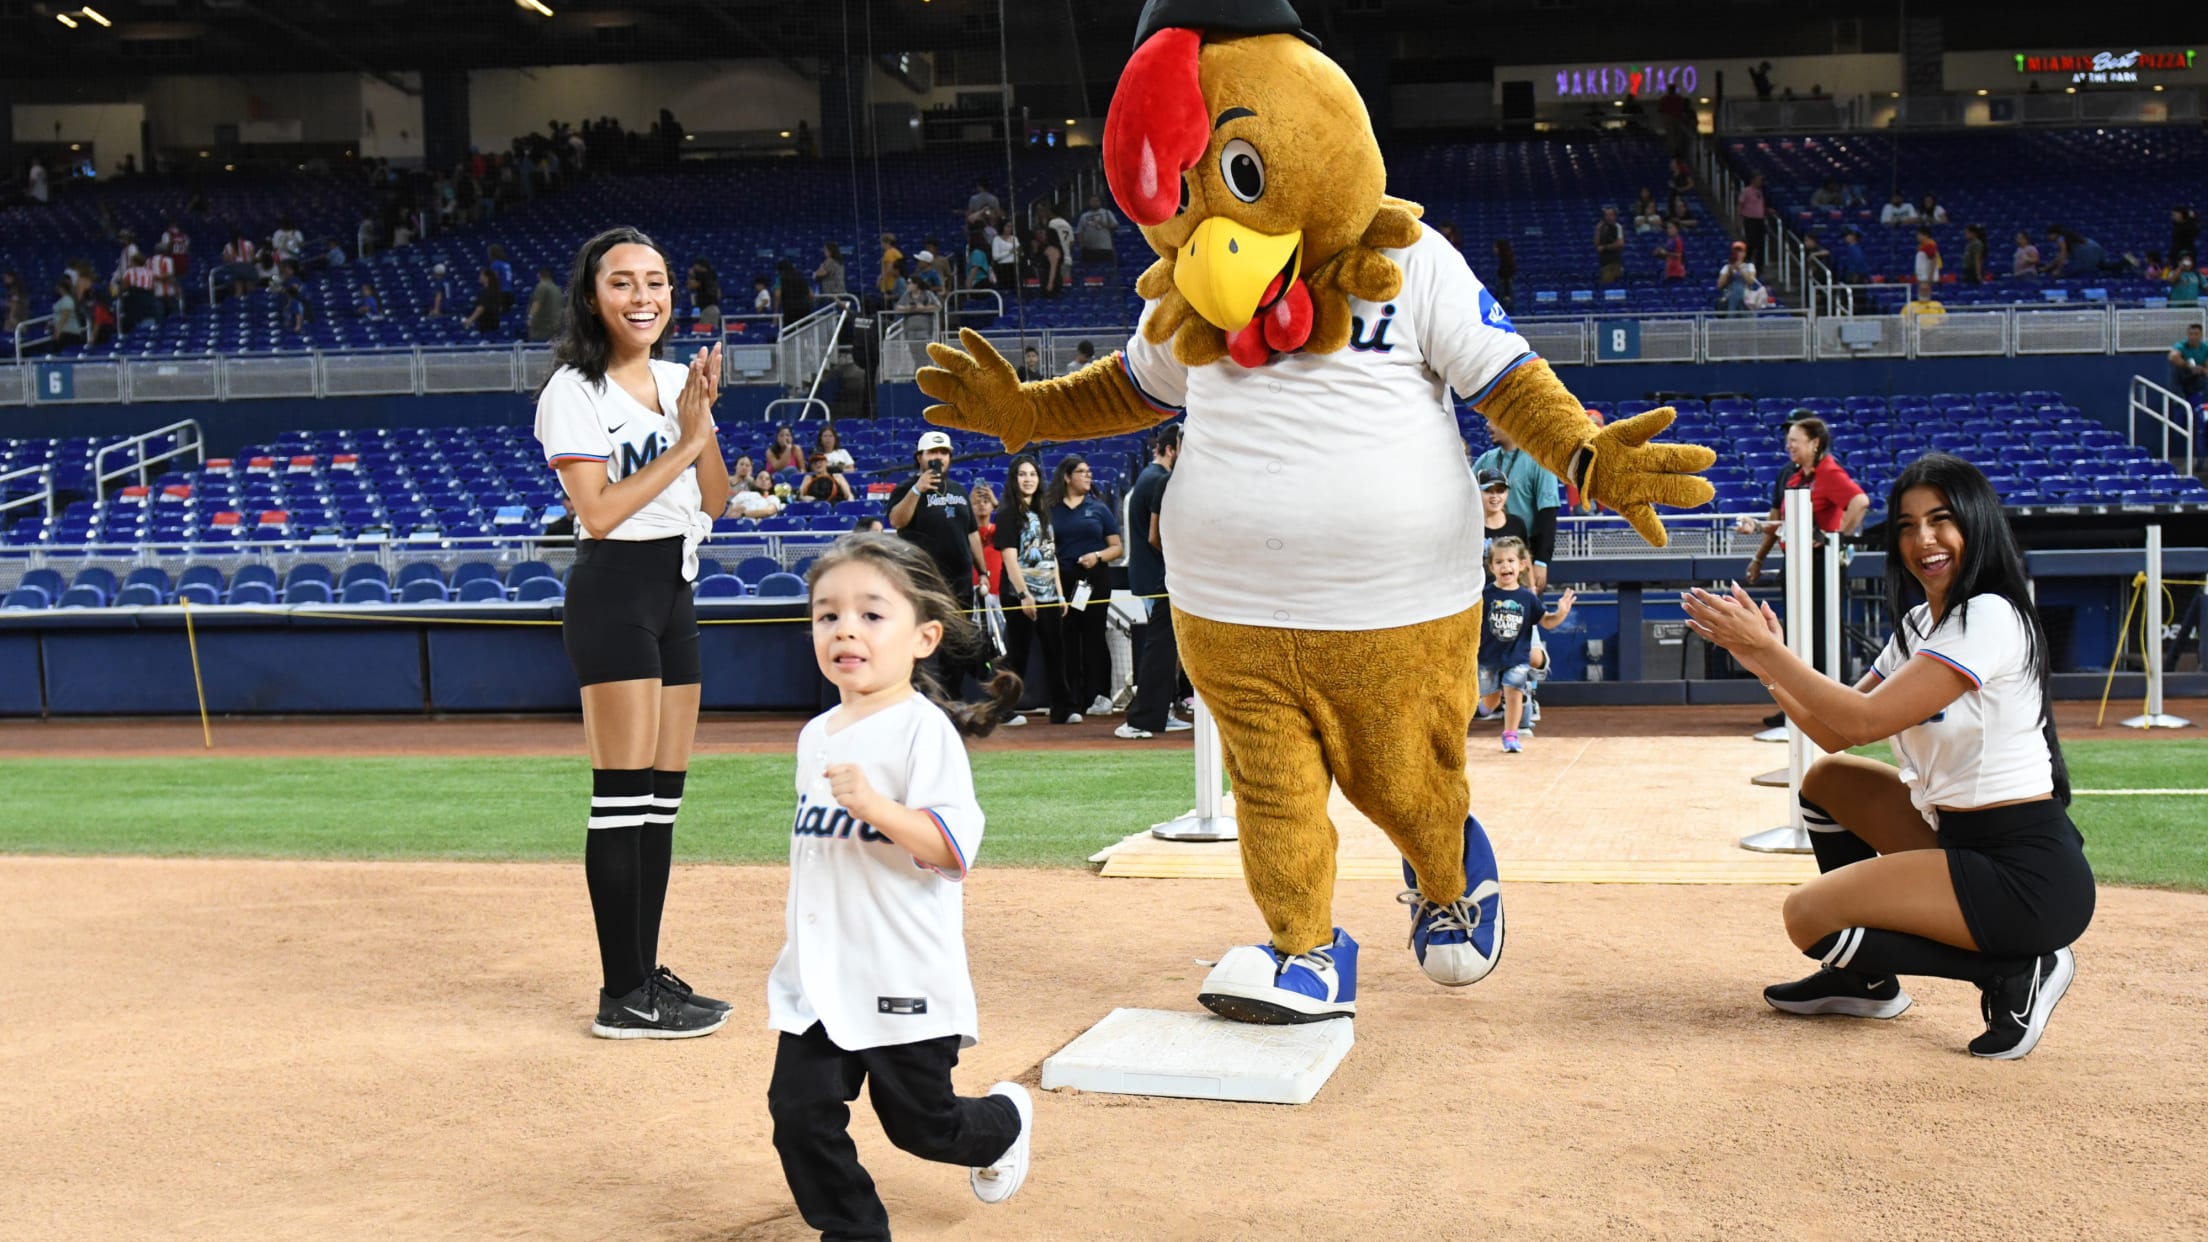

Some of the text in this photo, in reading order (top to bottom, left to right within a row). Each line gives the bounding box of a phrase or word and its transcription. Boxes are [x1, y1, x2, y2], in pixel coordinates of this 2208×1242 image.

[2092, 50, 2141, 72] Best
[2138, 53, 2186, 70] PIZZA
[1556, 65, 1698, 96] NAKED TACO
[2072, 72, 2138, 83] AT THE PARK
[1612, 328, 1626, 352] 8
[49, 371, 62, 394] 6
